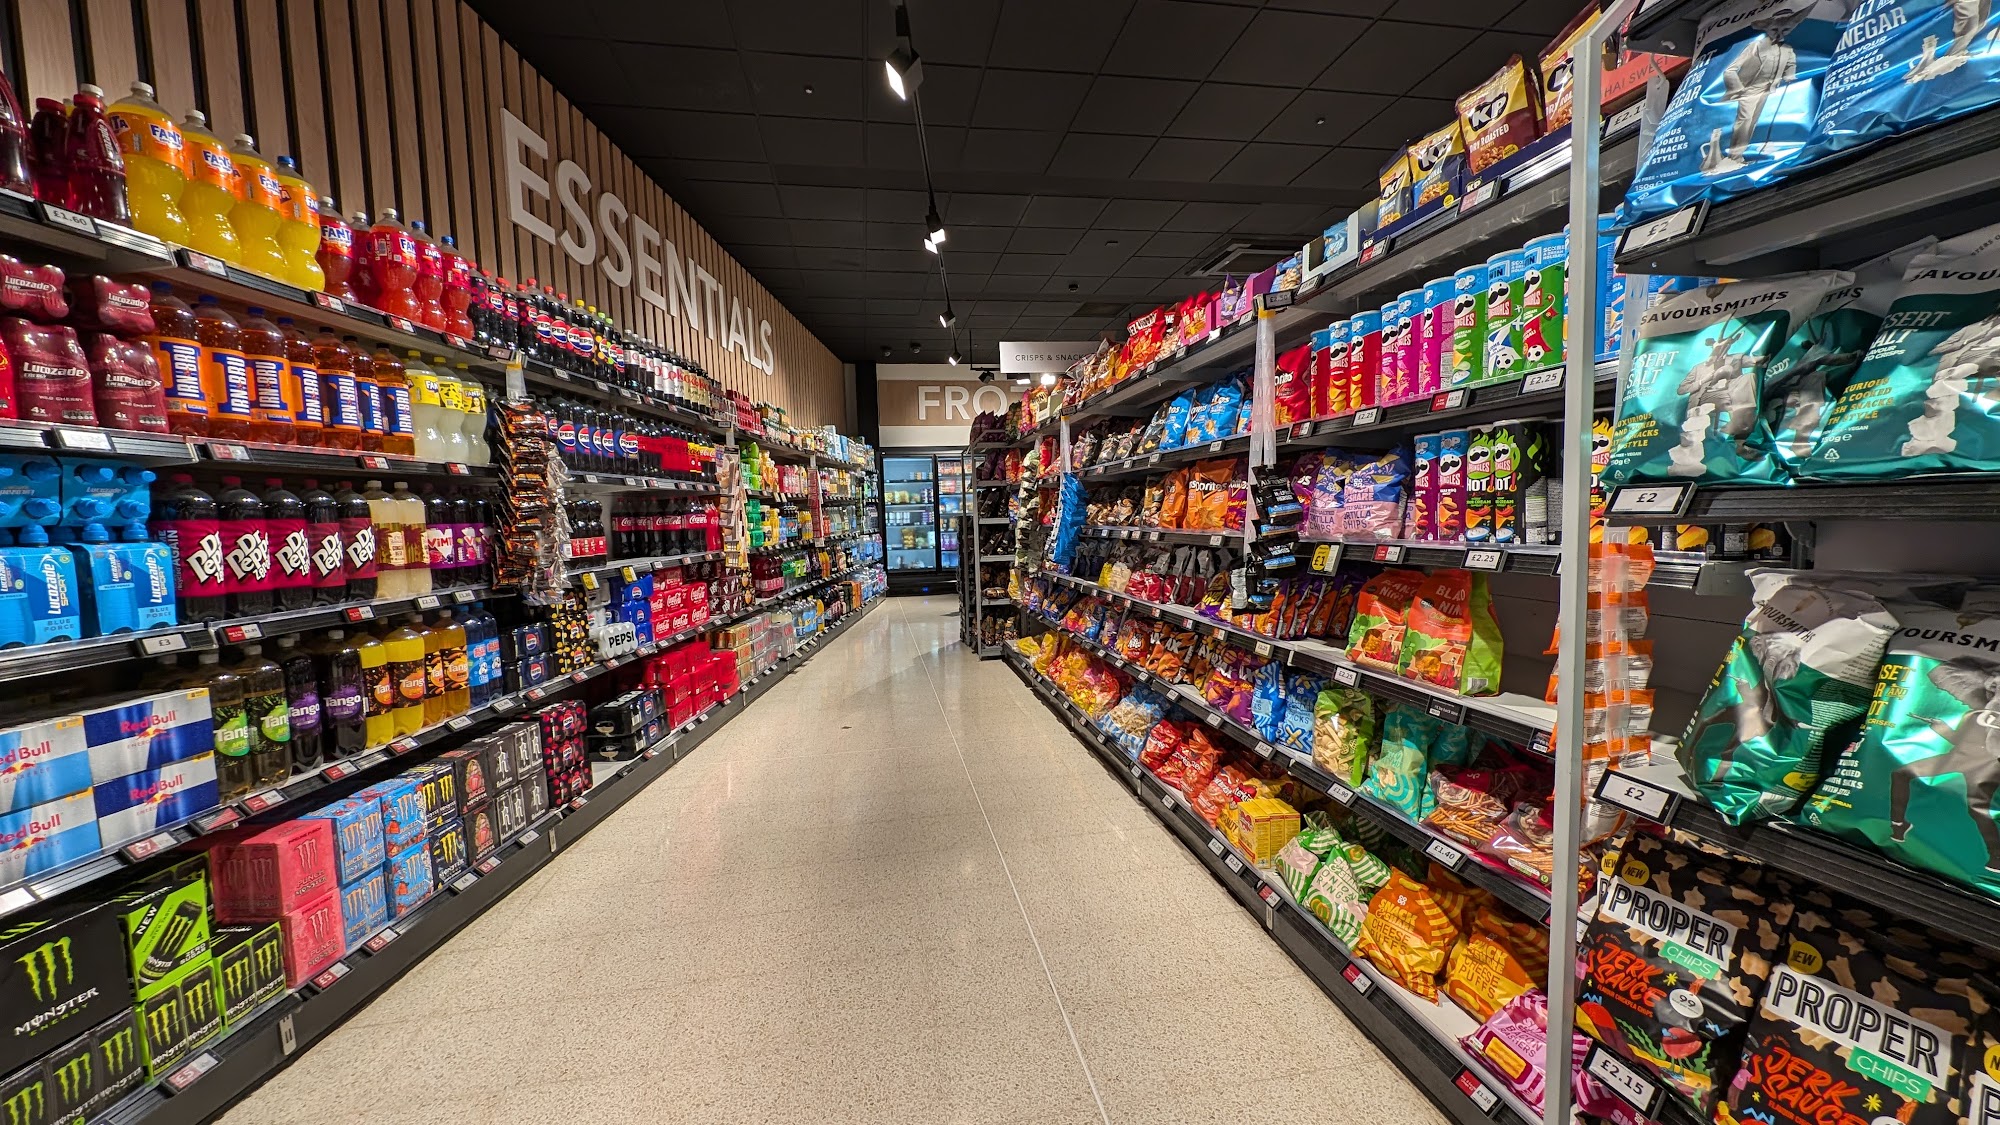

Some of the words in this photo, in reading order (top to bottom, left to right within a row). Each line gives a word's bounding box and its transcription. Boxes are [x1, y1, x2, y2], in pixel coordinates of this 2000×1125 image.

[1843, 60, 1890, 84] SNACKS
[1603, 80, 1626, 98] HAI
[1469, 95, 1509, 128] KP
[1613, 103, 1646, 126] £2.1
[150, 124, 182, 146] FANT
[1480, 123, 1510, 146] ROASTED
[1652, 153, 1678, 165] STYLE
[1466, 178, 1482, 192] KP
[52, 208, 87, 228] £1.60
[1647, 221, 1668, 237] £2
[321, 224, 351, 243] FANT
[502, 107, 775, 376] ESSENTIALS
[5, 275, 51, 292] Lucozade
[108, 292, 145, 308] Lucozade
[1640, 289, 1790, 326] SAVOURSMITHS
[1871, 328, 1919, 348] ALT
[1014, 353, 1044, 362] CRISPS
[1046, 353, 1053, 361] &
[1055, 353, 1087, 362] SNACK
[23, 361, 84, 379] Lucozade
[172, 344, 201, 399] IRN-BRU
[1529, 373, 1558, 386] £2.25
[1626, 368, 1662, 390] SALT
[227, 356, 251, 414] IRN-BRU
[254, 360, 281, 409] IRN-BRU
[302, 369, 322, 421] IRN-BRU
[917, 385, 1031, 420] FRO
[1357, 411, 1374, 421] £2.25
[1616, 412, 1653, 428] UXURIOUS
[1636, 492, 1659, 503] £2
[1343, 508, 1372, 520] ORTILLA
[1343, 519, 1368, 530] CHIPS
[200, 529, 221, 553] Dr
[236, 529, 261, 552] Dr
[285, 529, 305, 550] Dr
[322, 532, 340, 551] Dr
[355, 526, 373, 545] Dr
[167, 529, 180, 567] AGAIN
[1471, 553, 1495, 563] £2.25
[1312, 555, 1326, 567] £1
[42, 563, 62, 615] Lucozade
[57, 573, 70, 607] SPORT
[146, 556, 163, 603] Lucozade
[157, 564, 168, 596] SPORT
[47, 618, 71, 626] BLUE
[146, 611, 172, 619] FORCE
[44, 624, 74, 632] FORCE
[159, 638, 171, 647] £3
[608, 630, 635, 649] PEPSI
[447, 663, 468, 673] Tang
[400, 678, 425, 689] Tang
[323, 694, 362, 709] Tango
[119, 715, 150, 734] Red
[151, 709, 177, 726] Bull
[18, 740, 51, 761] Bull
[129, 785, 158, 801] Red
[159, 773, 184, 791] Bull
[1333, 785, 1350, 798] £1.90
[1624, 786, 1645, 802] £2
[29, 813, 61, 835] Bull
[1433, 842, 1456, 862] £1.40
[1321, 868, 1358, 901] ONION
[1624, 867, 1646, 880] NEW
[1316, 875, 1349, 903] RINGS
[136, 906, 158, 935] NEW
[1378, 898, 1418, 926] SNACK
[1607, 883, 1730, 963] PROPER
[371, 938, 384, 948] £5
[1370, 928, 1408, 956] PUFFS
[1371, 918, 1411, 946] CHEESE
[1596, 941, 1665, 984] JERK
[1665, 944, 1714, 976] CHIPS
[318, 974, 335, 988] £5
[1459, 965, 1496, 1000] PUFFS
[1464, 956, 1501, 989] CHEESE
[1592, 962, 1668, 1008] SAUCE
[14, 986, 99, 1037] MONSTER
[1678, 993, 1697, 1008] 99
[29, 1003, 89, 1037] ENERGY
[1771, 970, 1940, 1079] PROPER
[1505, 1024, 1544, 1052] BACON
[1600, 1058, 1645, 1096] £2.15
[1763, 1046, 1861, 1109] JERK
[1855, 1054, 1922, 1095] CHIPS
[1476, 1089, 1493, 1105] £1.20
